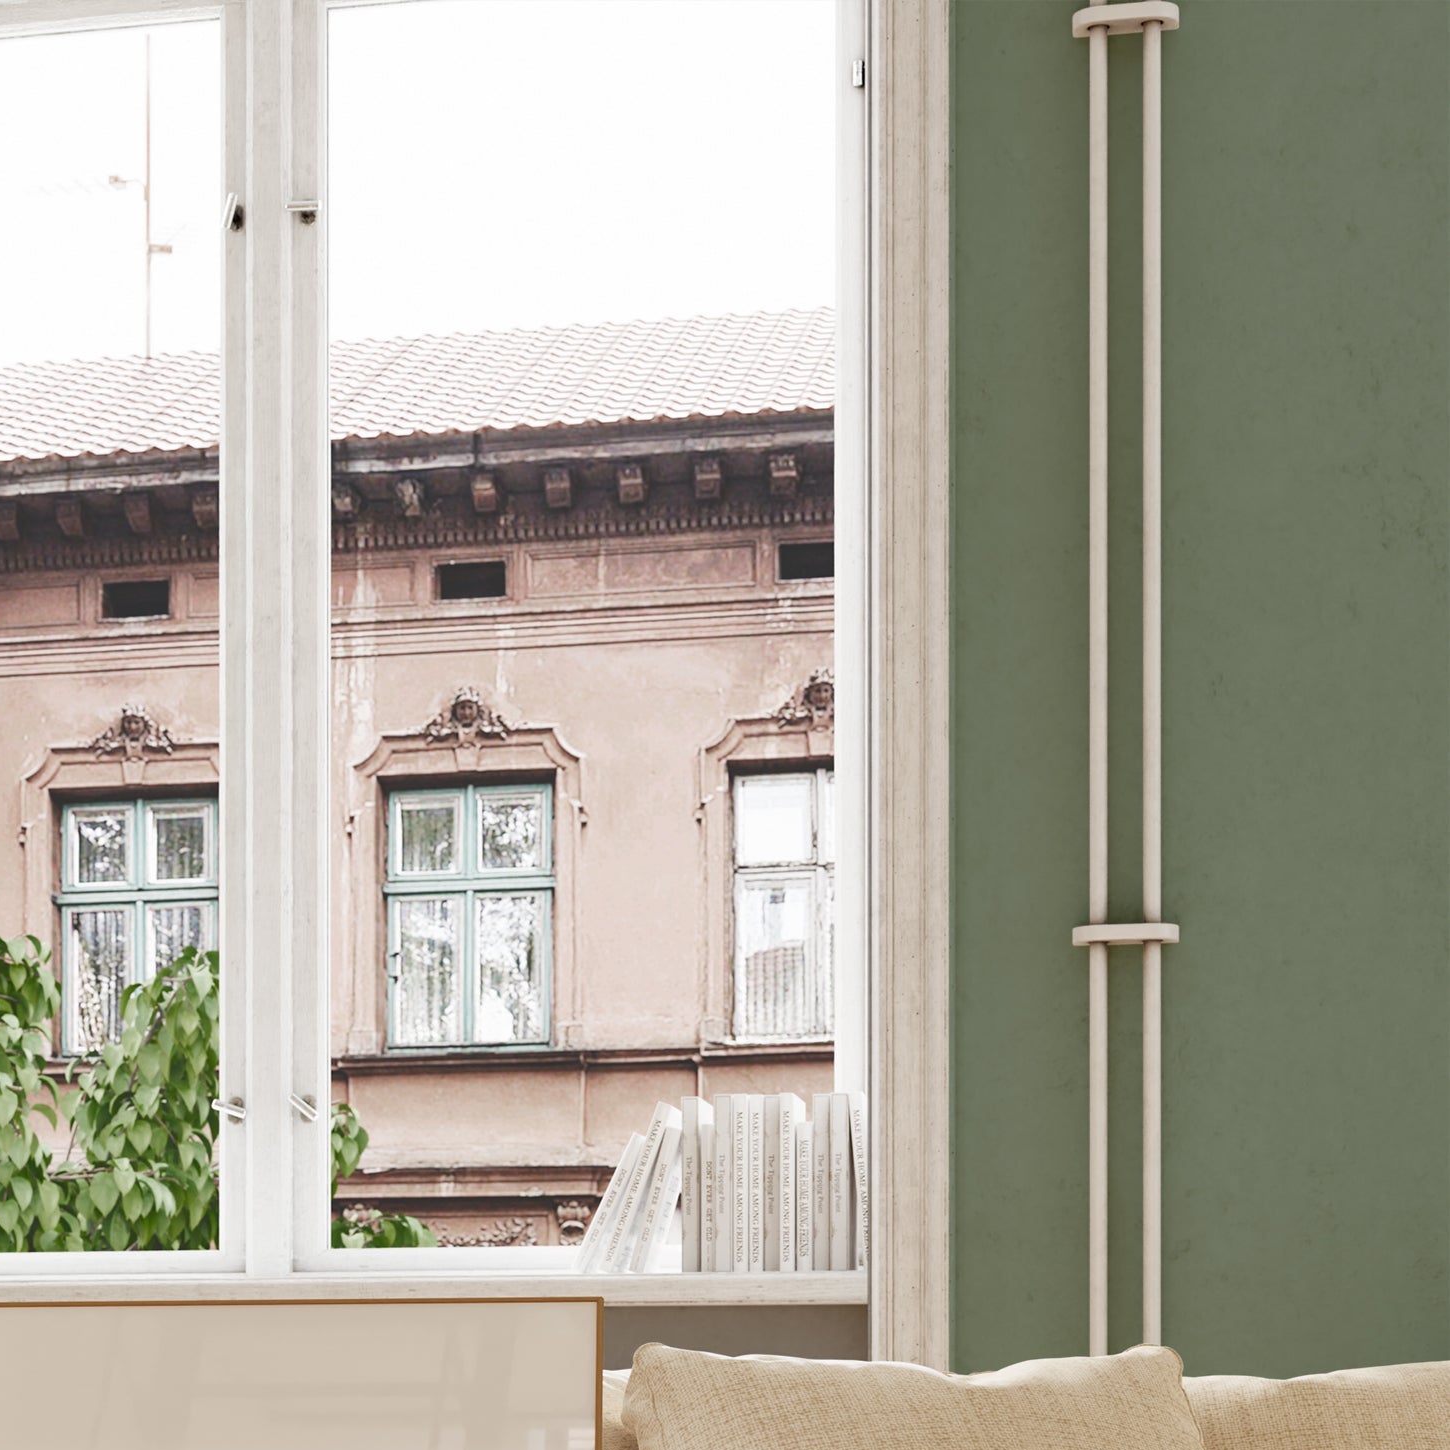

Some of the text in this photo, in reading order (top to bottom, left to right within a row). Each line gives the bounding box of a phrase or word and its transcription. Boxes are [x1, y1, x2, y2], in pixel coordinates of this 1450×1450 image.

[853, 1110, 861, 1133] MAKE
[855, 1135, 863, 1158] YOUR
[857, 1161, 865, 1188] HOME
[605, 1120, 662, 1262] MAKE YOUR HOME AMONG FRIENDS
[799, 1140, 809, 1257] MAKE YOUR HOME AMONG FRIENDS
[860, 1190, 868, 1222] AMONG
